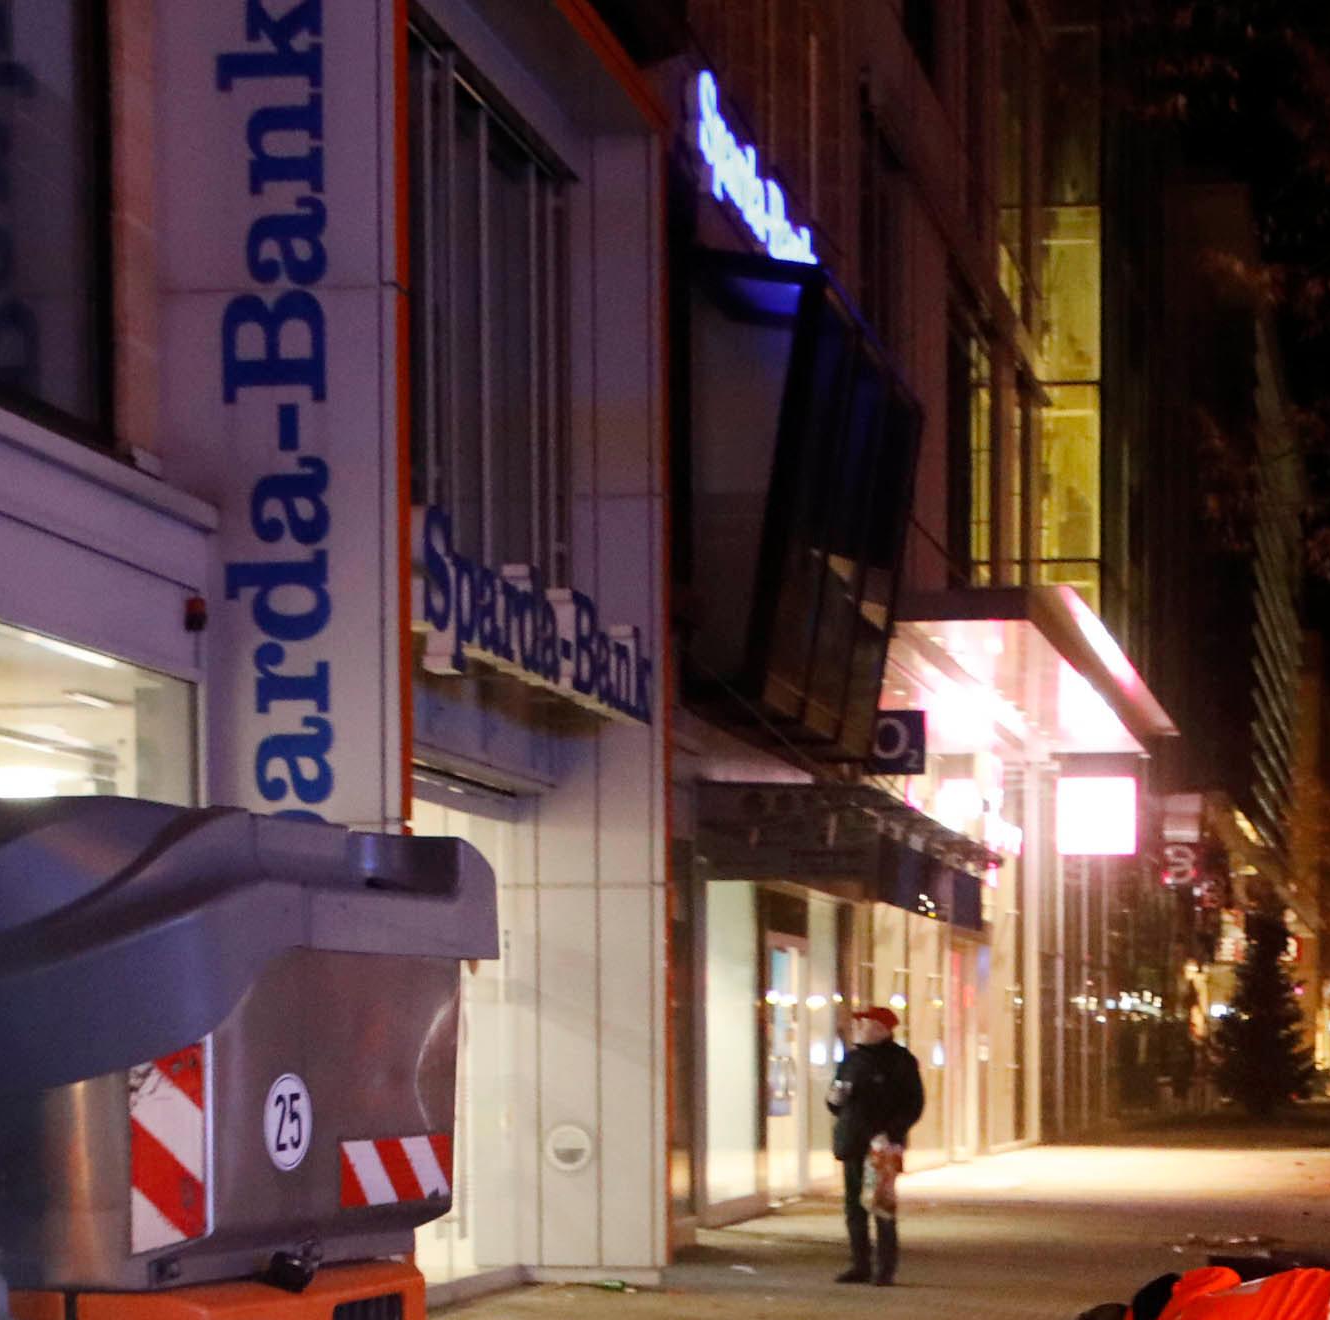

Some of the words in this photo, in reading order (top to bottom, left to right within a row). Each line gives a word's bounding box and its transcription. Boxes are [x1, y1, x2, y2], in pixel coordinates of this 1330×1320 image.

[216, 0, 334, 824] arda-Bank
[423, 503, 655, 727] Sparda-Bank
[273, 1092, 302, 1152] 25
